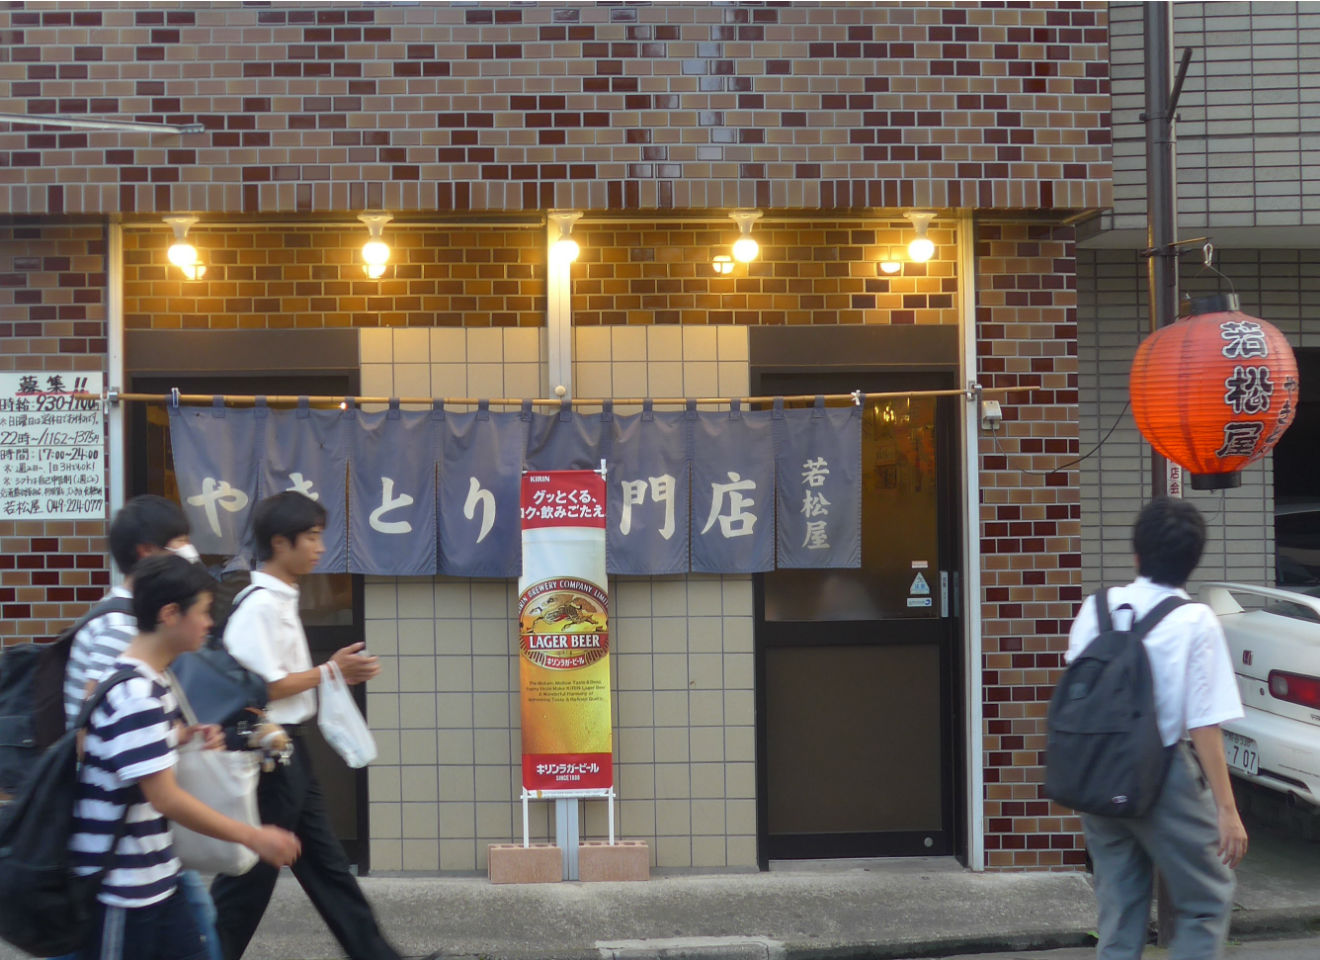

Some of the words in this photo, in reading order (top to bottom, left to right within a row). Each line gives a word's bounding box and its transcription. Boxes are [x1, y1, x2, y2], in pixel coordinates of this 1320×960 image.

[1214, 320, 1274, 458] 若松屋
[530, 475, 550, 483] KIRIN
[533, 489, 597, 505] グッとくる、
[801, 456, 832, 550] 若松屋
[559, 579, 593, 593] COMPANY
[529, 635, 568, 649] LAGER
[571, 634, 600, 648] BEER
[536, 763, 600, 775] キリンラガービール
